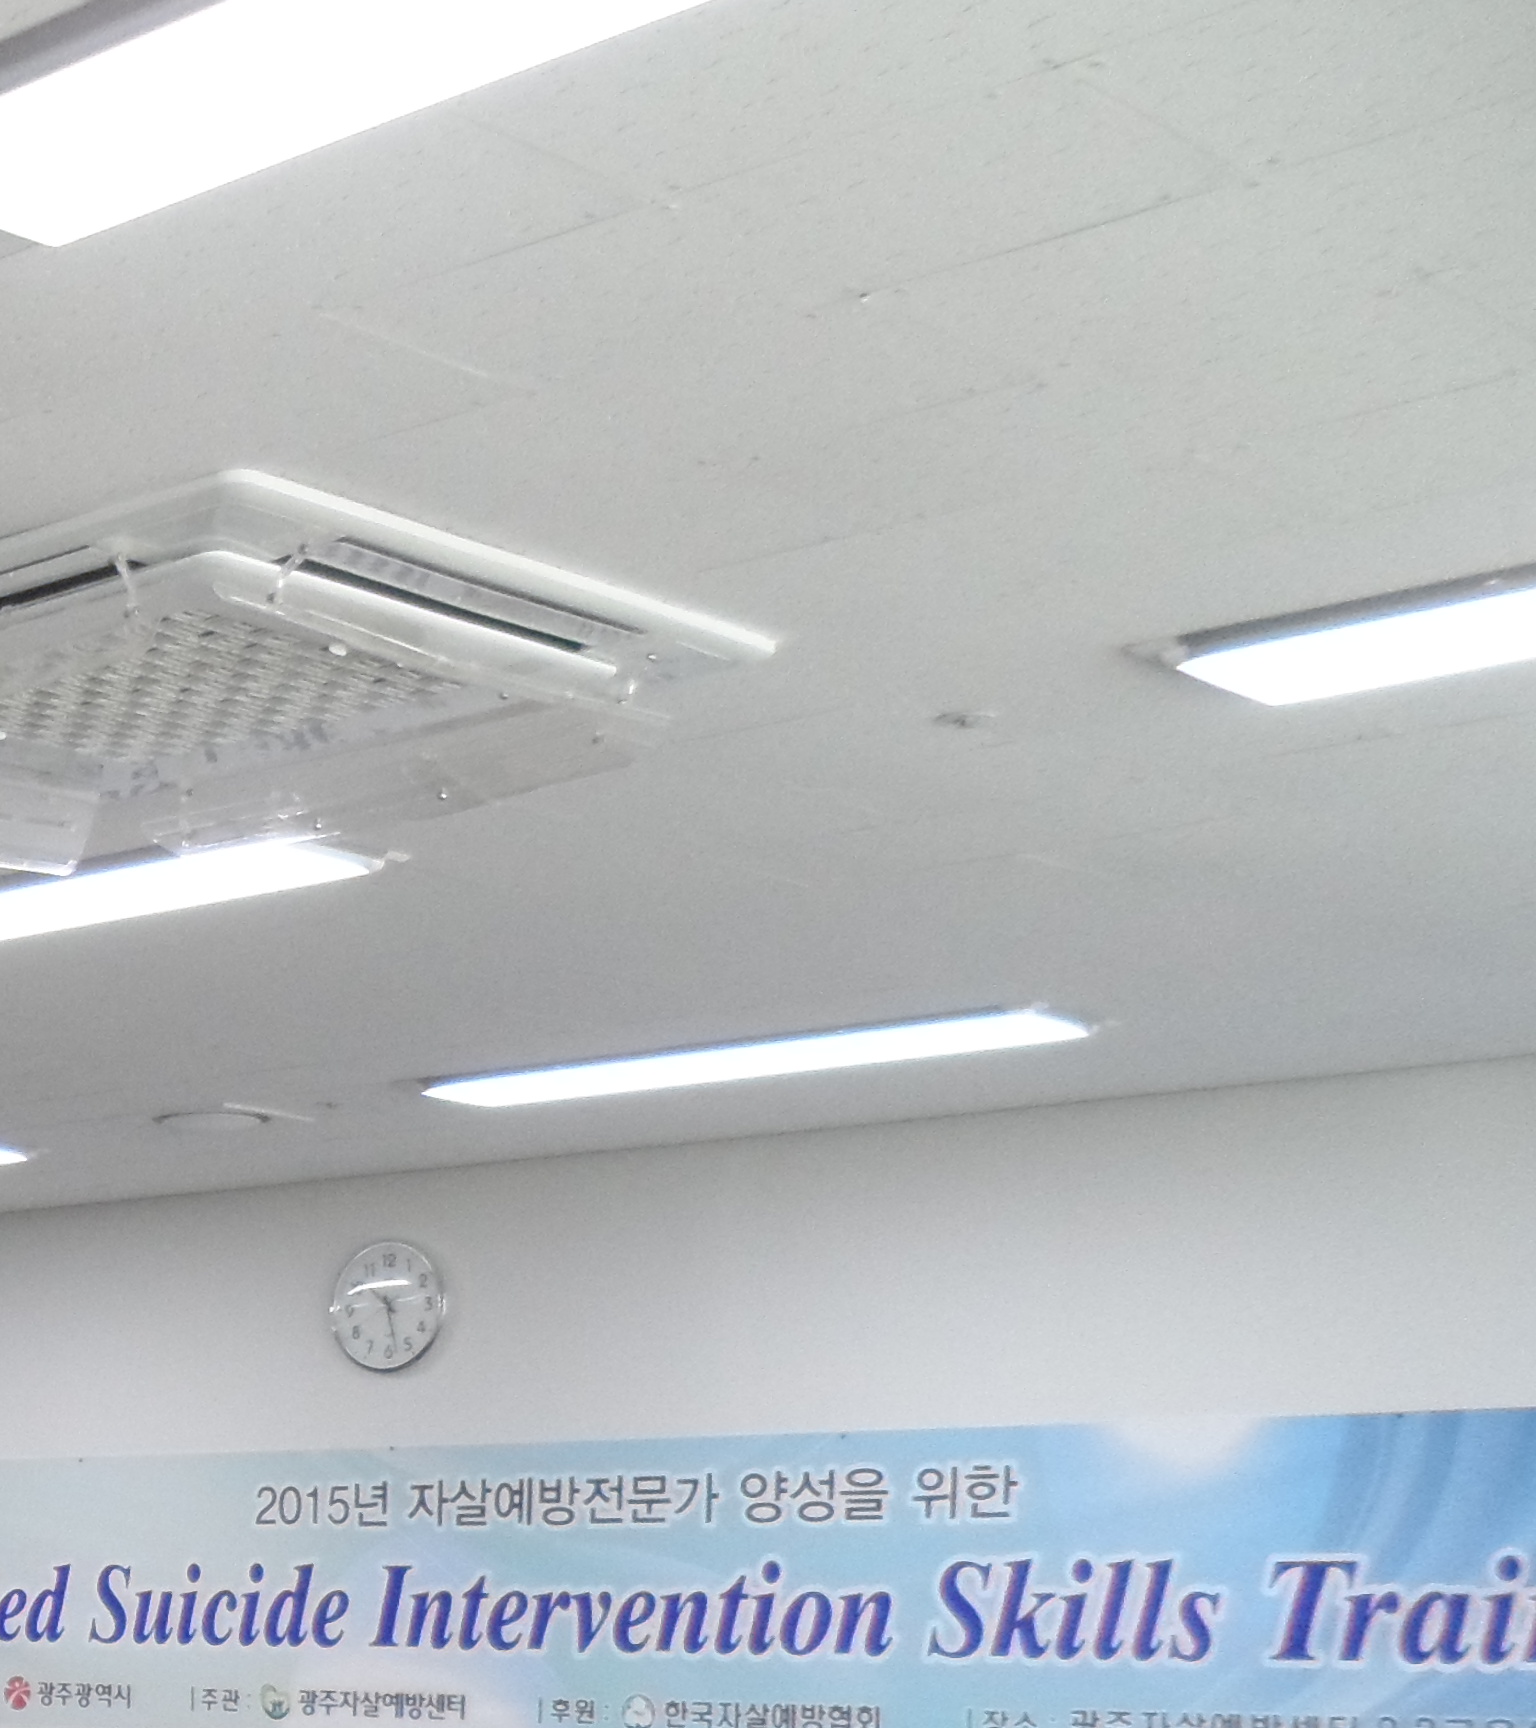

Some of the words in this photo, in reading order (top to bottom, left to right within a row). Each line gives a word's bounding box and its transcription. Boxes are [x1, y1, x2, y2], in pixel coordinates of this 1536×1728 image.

[382, 1253, 397, 1268] 12
[364, 1262, 375, 1277] 11
[418, 1273, 428, 1288] 2
[352, 1325, 361, 1340] 8
[416, 1321, 426, 1333] 4
[367, 1340, 374, 1354] 7
[403, 1337, 413, 1351] 5
[384, 1345, 393, 1359] 6
[254, 1480, 389, 1527] 2015년
[408, 1473, 720, 1527] 자살예방전문가
[740, 1467, 888, 1523] 양성을
[911, 1465, 1019, 1519] 위한
[89, 1563, 350, 1648] Suicide
[369, 1560, 893, 1658] Intervention
[928, 1558, 1222, 1662] Skills
[1268, 1555, 1536, 1664] Trai
[37, 1681, 131, 1708] 광주광역시
[298, 1689, 466, 1720] 광주자살예방센터
